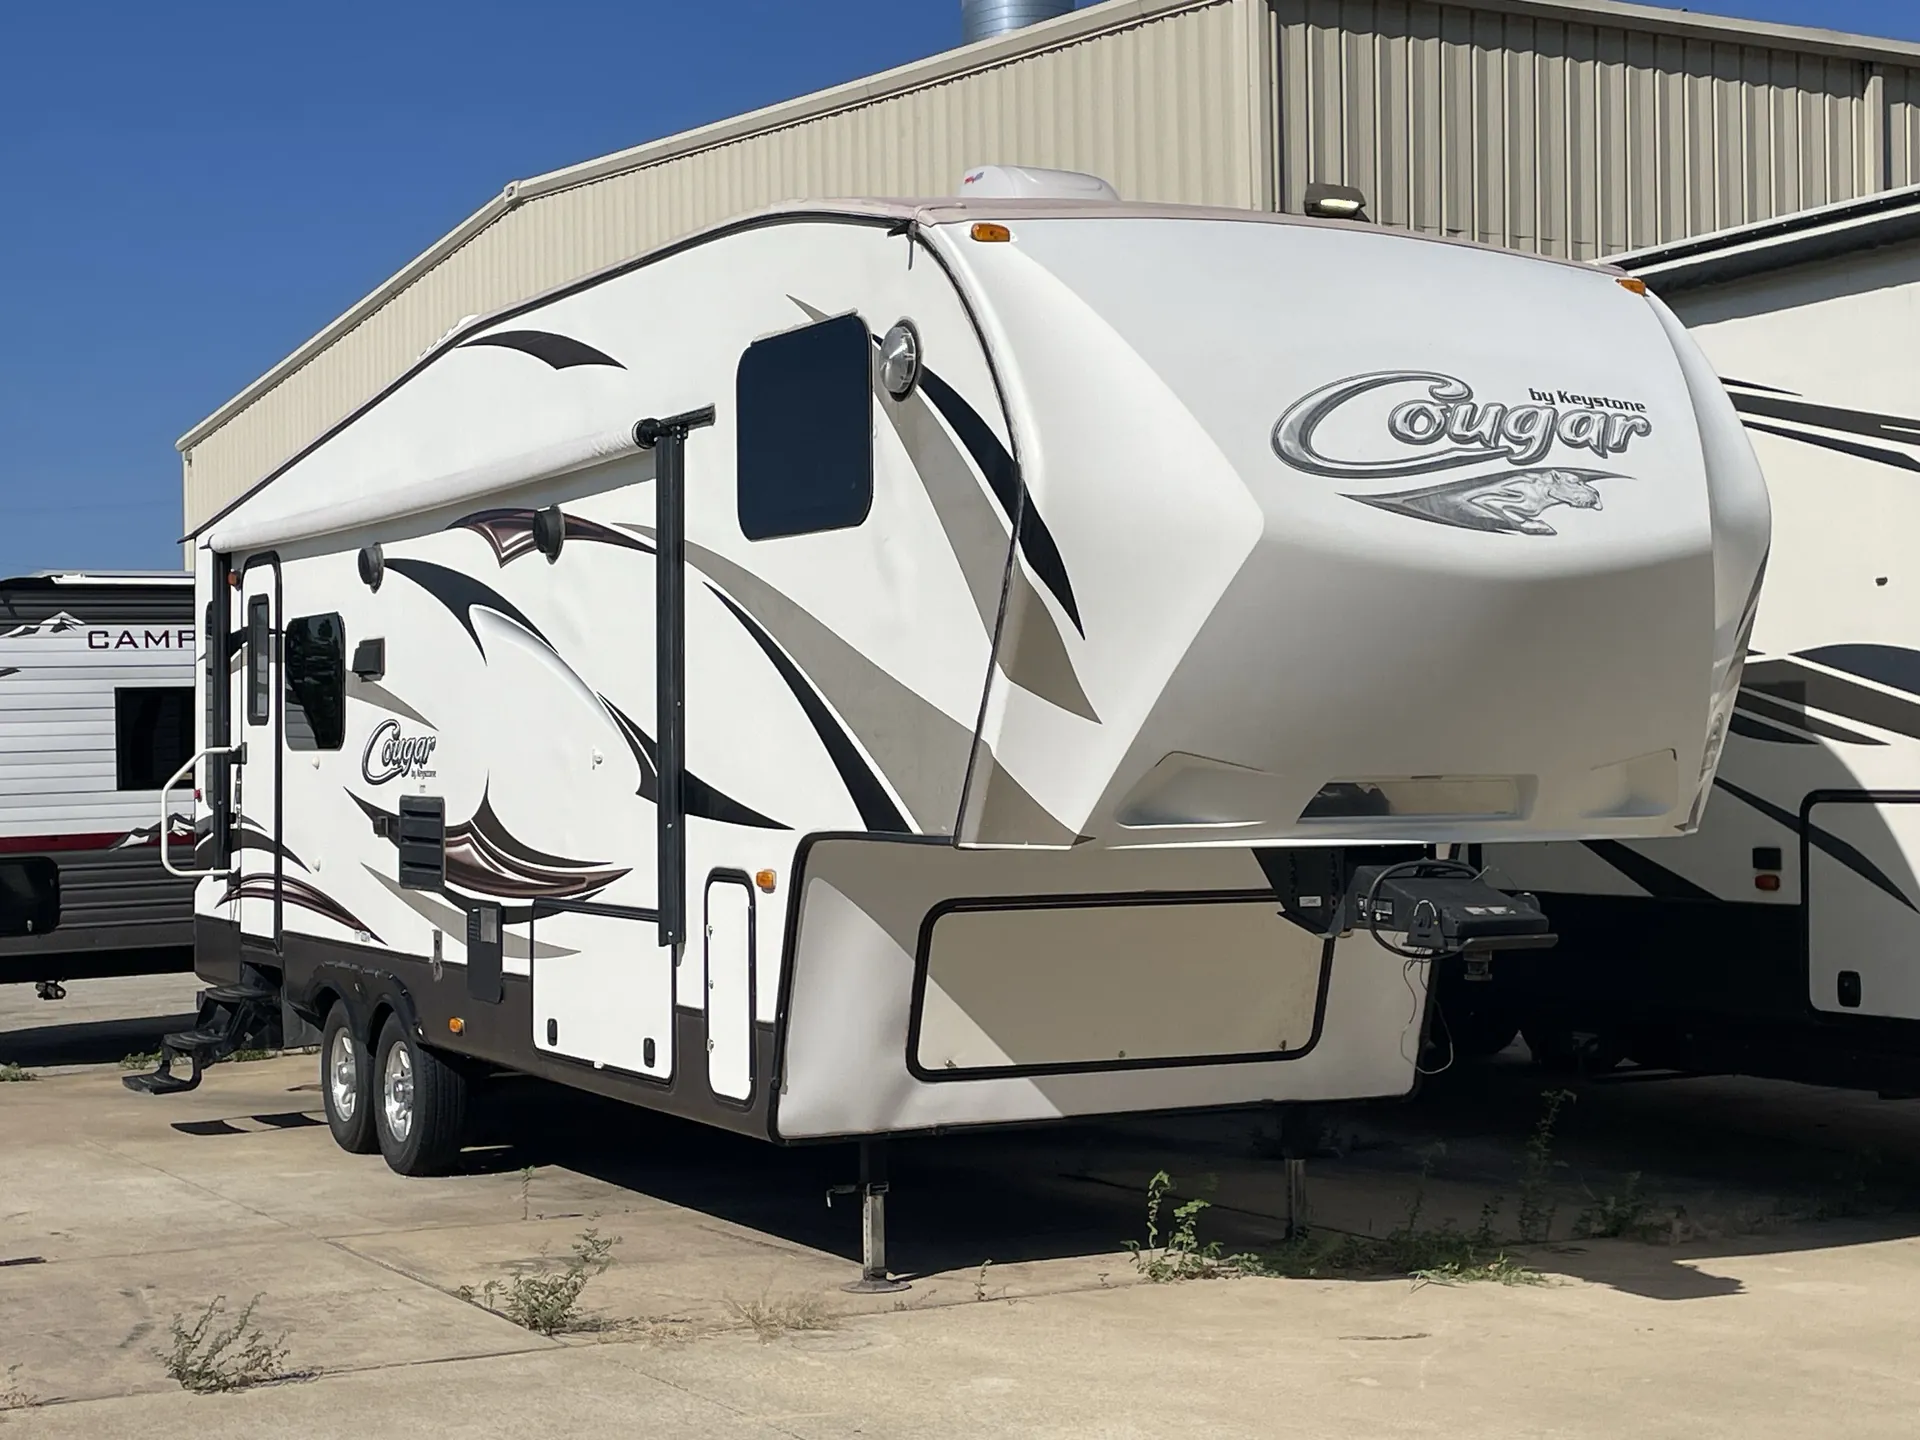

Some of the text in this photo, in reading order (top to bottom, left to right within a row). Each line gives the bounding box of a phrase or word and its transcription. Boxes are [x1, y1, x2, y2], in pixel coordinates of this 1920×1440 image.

[1271, 369, 1652, 479] Cougar
[1528, 388, 1647, 413] by Keystone
[361, 718, 436, 786] Cougar
